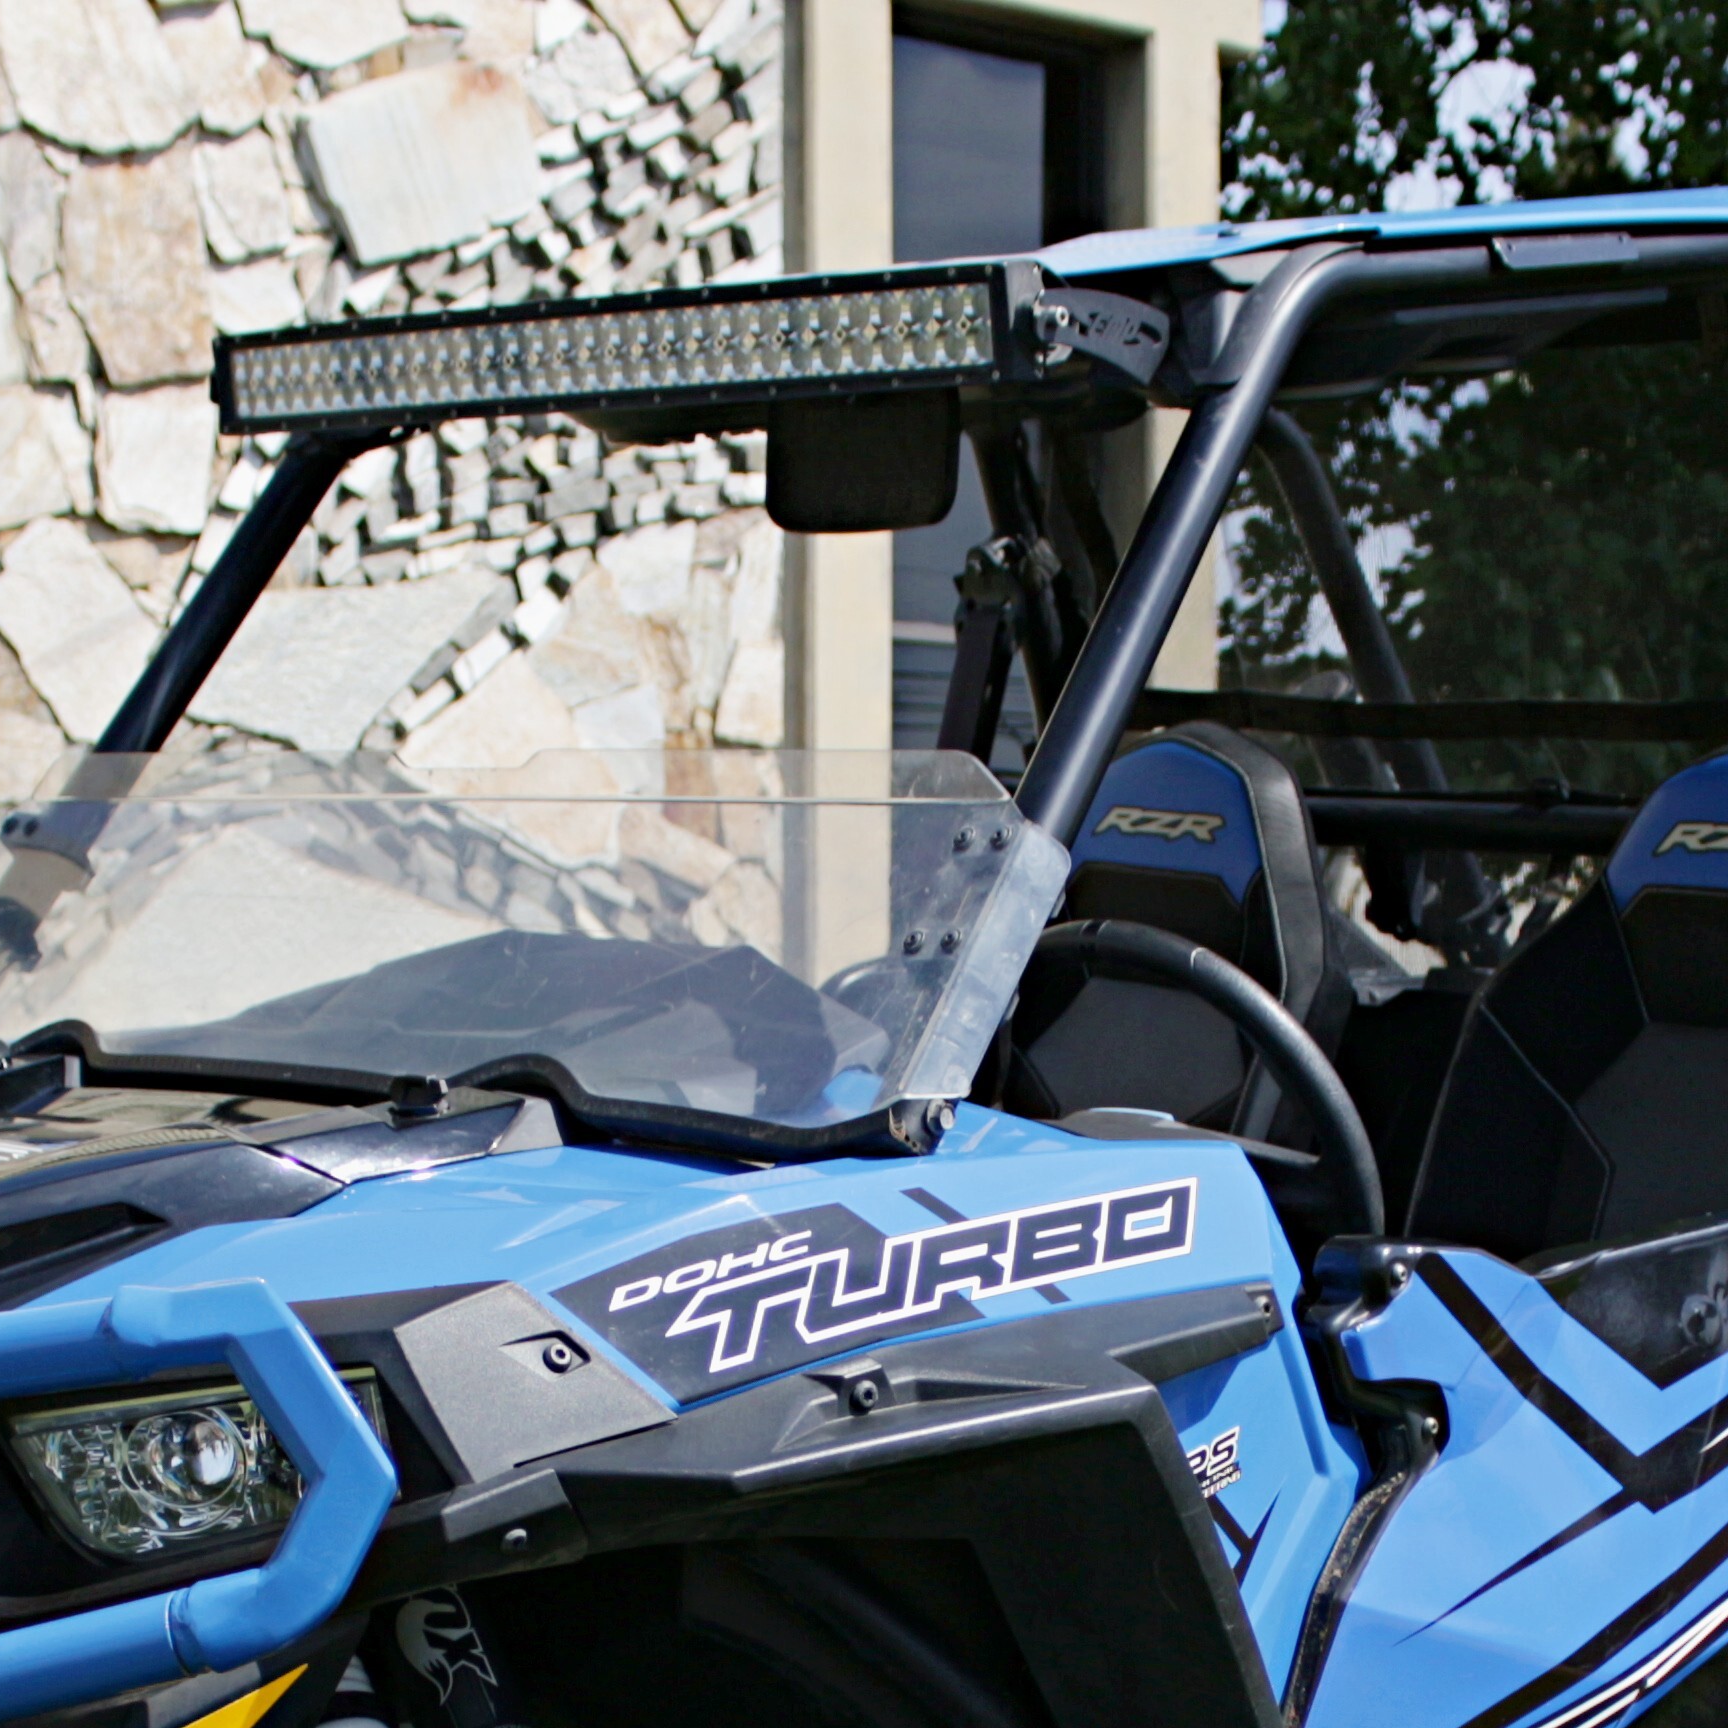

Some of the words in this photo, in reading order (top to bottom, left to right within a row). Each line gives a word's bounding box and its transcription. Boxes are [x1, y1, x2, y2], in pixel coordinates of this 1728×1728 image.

[1094, 805, 1225, 845] RZR
[608, 1230, 814, 1313] DOHC
[665, 1176, 1199, 1374] TURBO
